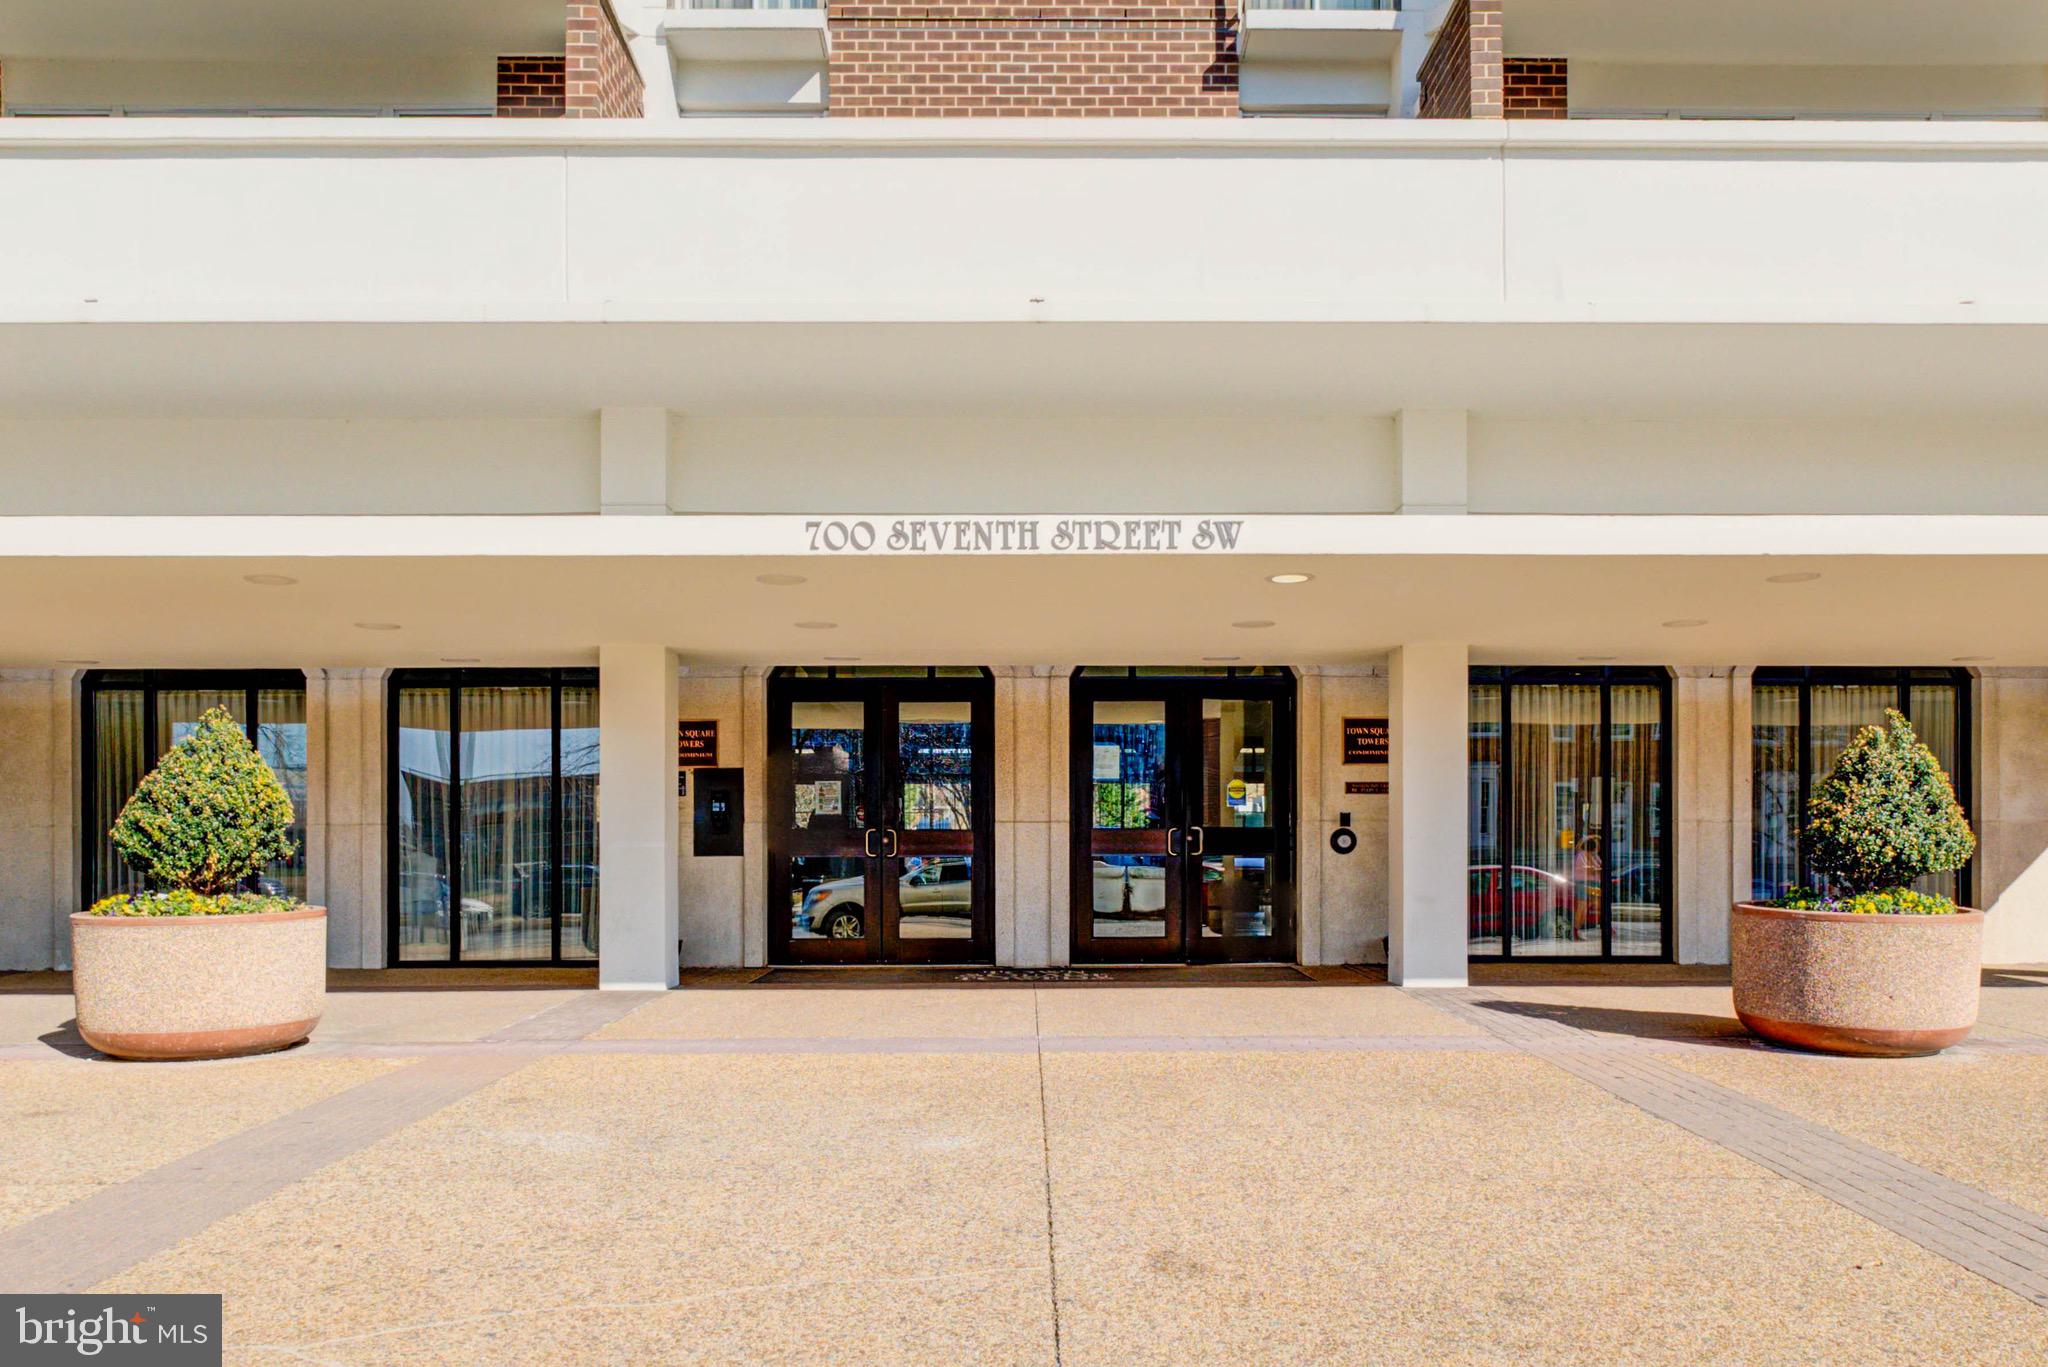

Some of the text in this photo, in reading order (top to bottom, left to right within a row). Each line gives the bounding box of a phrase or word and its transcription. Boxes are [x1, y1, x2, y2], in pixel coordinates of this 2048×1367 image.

[804, 520, 1245, 552] 700 SEVENTH STREET SW
[685, 729, 715, 739] SQUARE
[1346, 727, 1369, 735] TOWN
